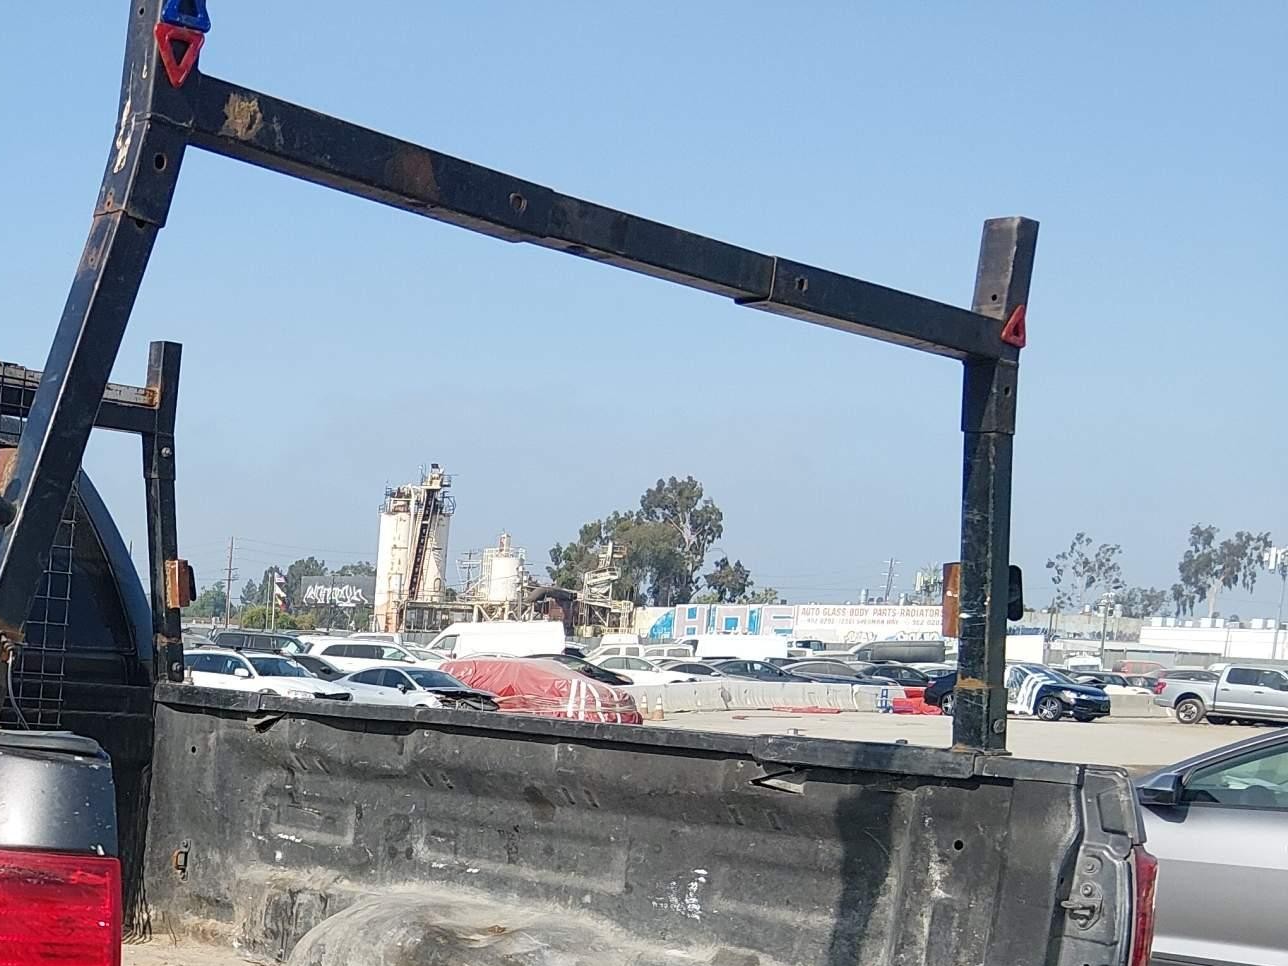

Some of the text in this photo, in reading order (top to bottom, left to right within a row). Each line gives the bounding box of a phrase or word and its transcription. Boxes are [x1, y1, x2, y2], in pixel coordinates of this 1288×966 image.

[801, 608, 820, 616] AUTO
[823, 608, 846, 616] GLASS
[873, 608, 897, 617] PARTS
